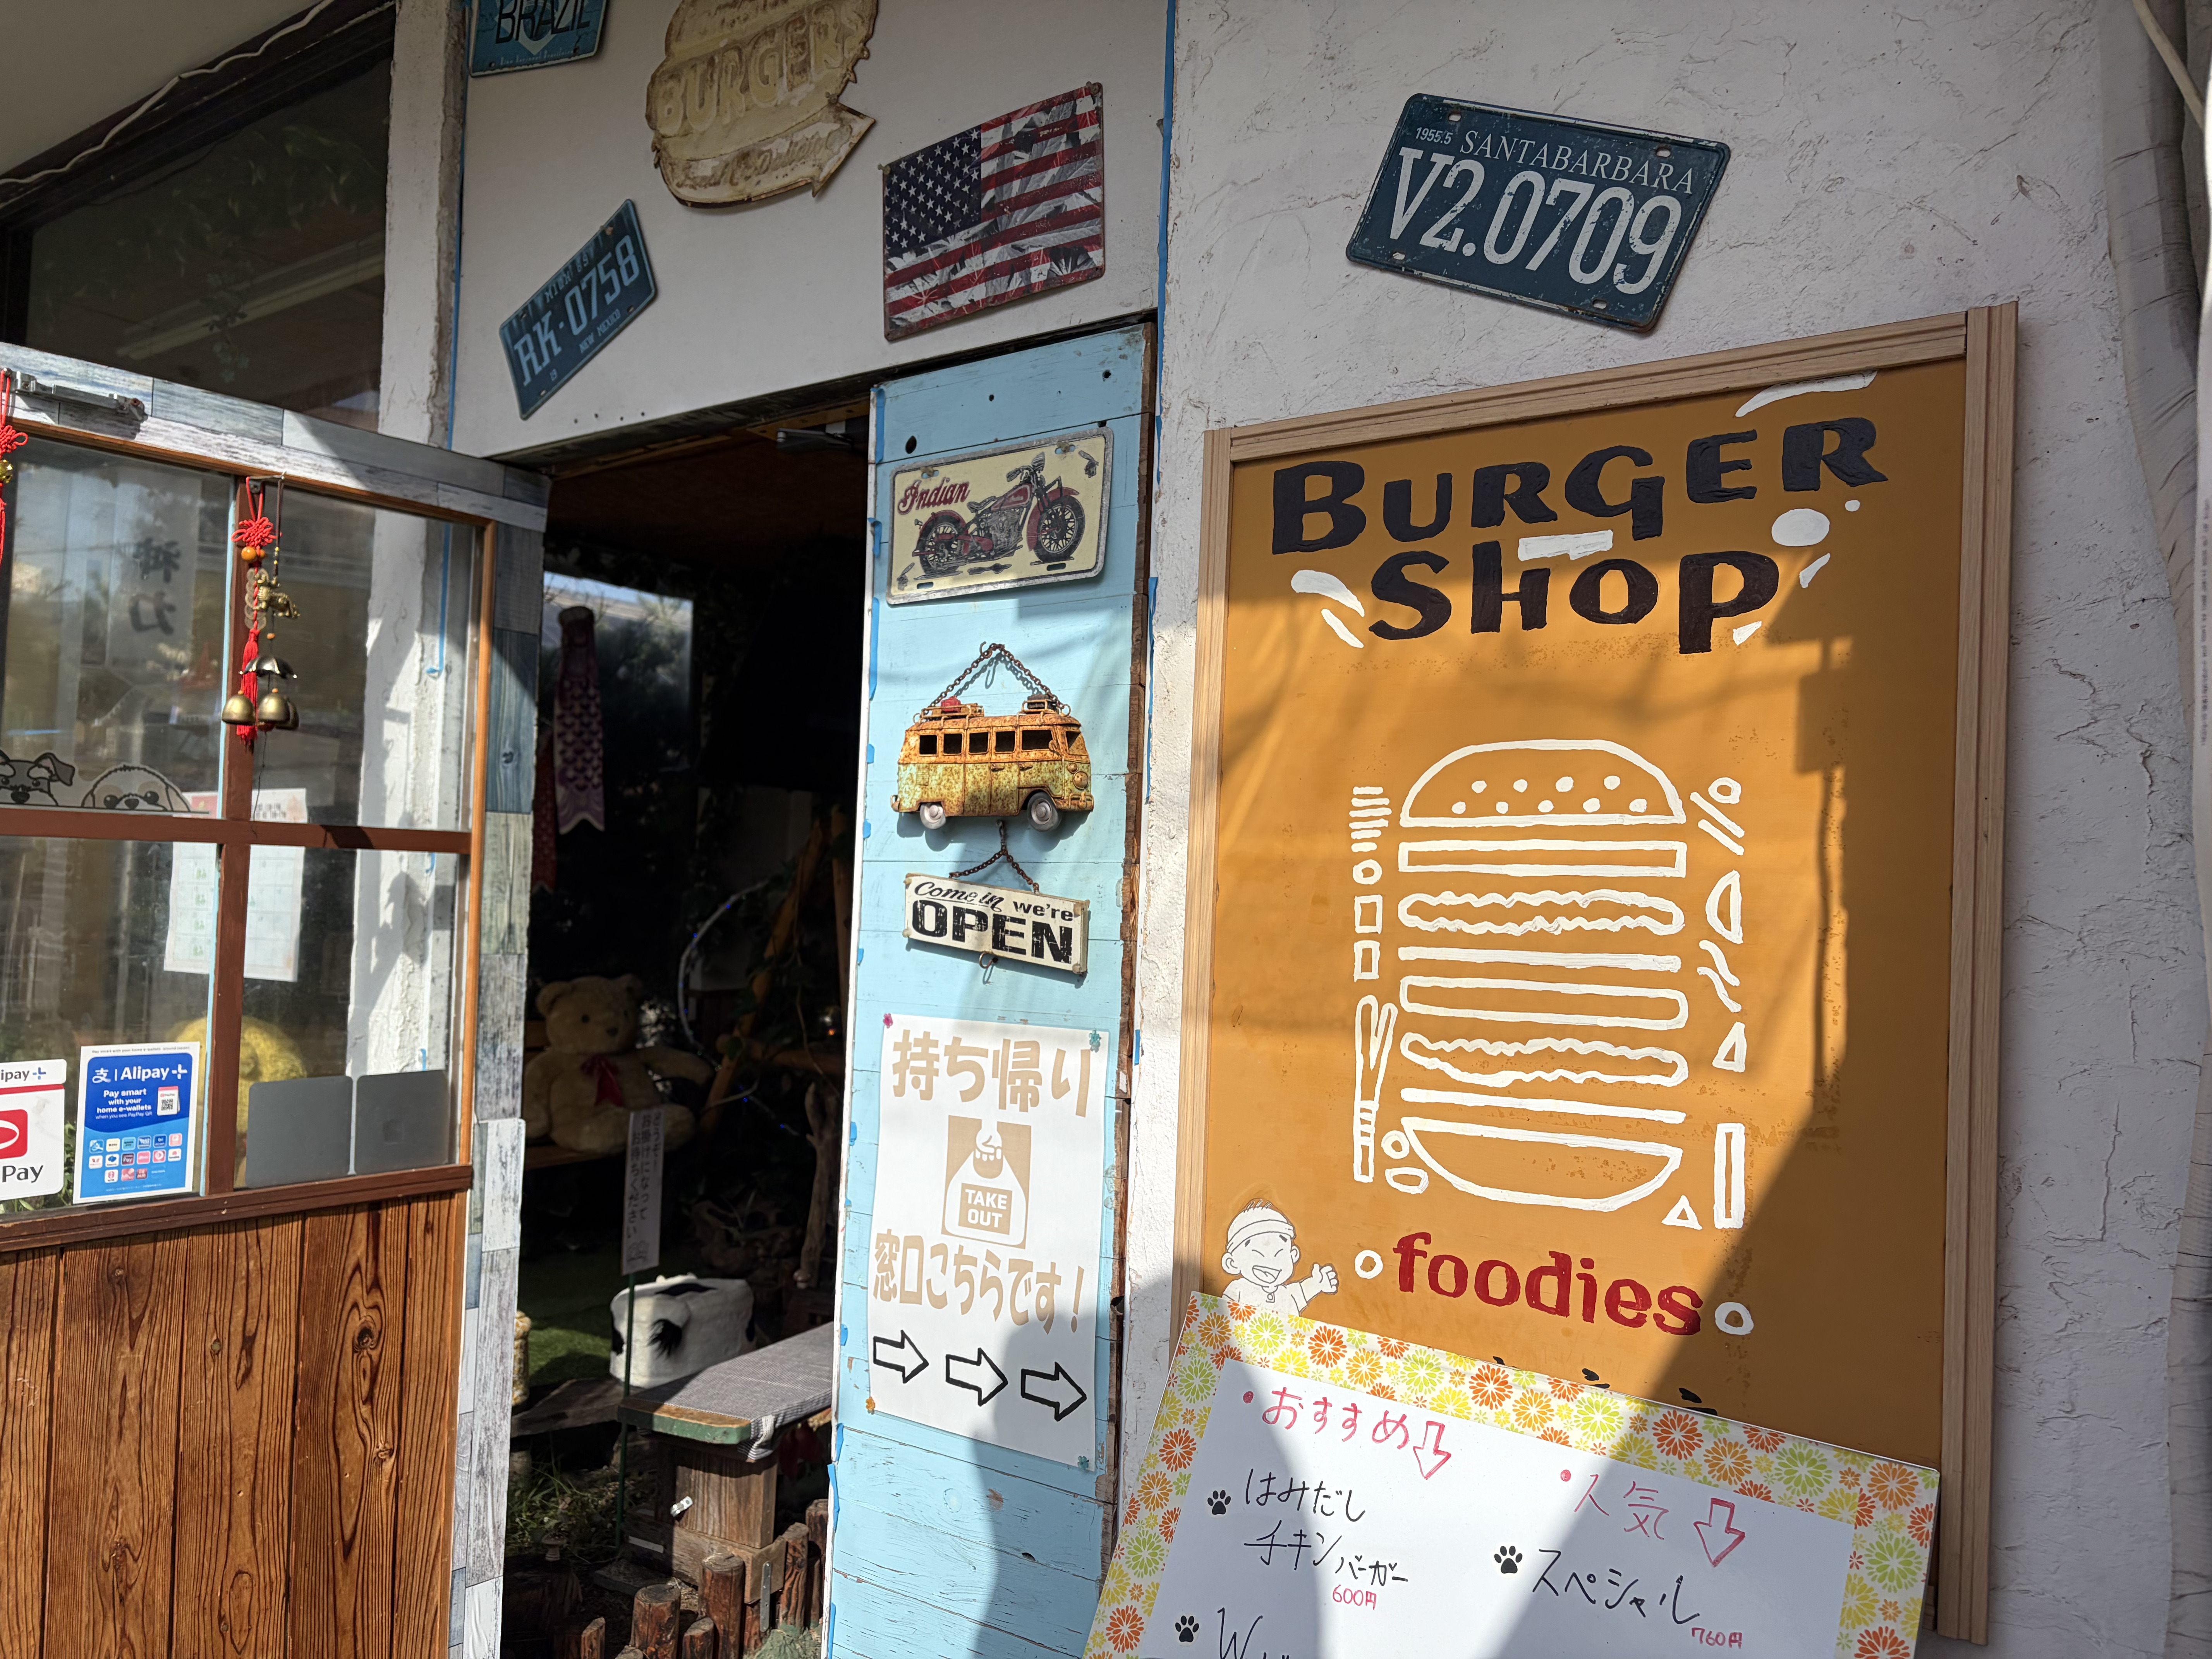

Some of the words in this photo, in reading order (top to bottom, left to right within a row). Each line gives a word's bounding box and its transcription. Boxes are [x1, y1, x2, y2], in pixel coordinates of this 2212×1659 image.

[495, 0, 590, 44] BRAZIL
[1415, 126, 1453, 146] 1955.5
[1459, 129, 1693, 195] SANTABARBARA
[1389, 146, 1682, 294] V2.0709
[579, 334, 594, 354] NEW
[596, 308, 621, 337] MEXICO
[898, 477, 971, 515] Indian
[1273, 416, 1889, 555] BURGER
[1369, 541, 1779, 654] SHOP
[914, 881, 978, 903] Come
[979, 891, 1004, 913] in
[1013, 901, 1073, 922] we're
[912, 899, 1073, 964] OPEN
[103, 1090, 119, 1098] Pay
[121, 1088, 146, 1096] smart
[892, 1029, 1091, 1118] 持ち帰り
[118, 1104, 151, 1112] e-wallets
[2, 1165, 43, 1183] Pay
[965, 1188, 1007, 1210] TAKE
[967, 1208, 1002, 1228] OUT
[1392, 1231, 1704, 1337] foodies
[1262, 1386, 1410, 1449] おすすめ
[1245, 1468, 1366, 1522] はみだし
[1574, 1474, 1669, 1540] 人気
[1332, 1584, 1377, 1610] 600円
[1532, 1549, 1700, 1625] スペシャル
[1691, 1627, 1743, 1649] 760円
